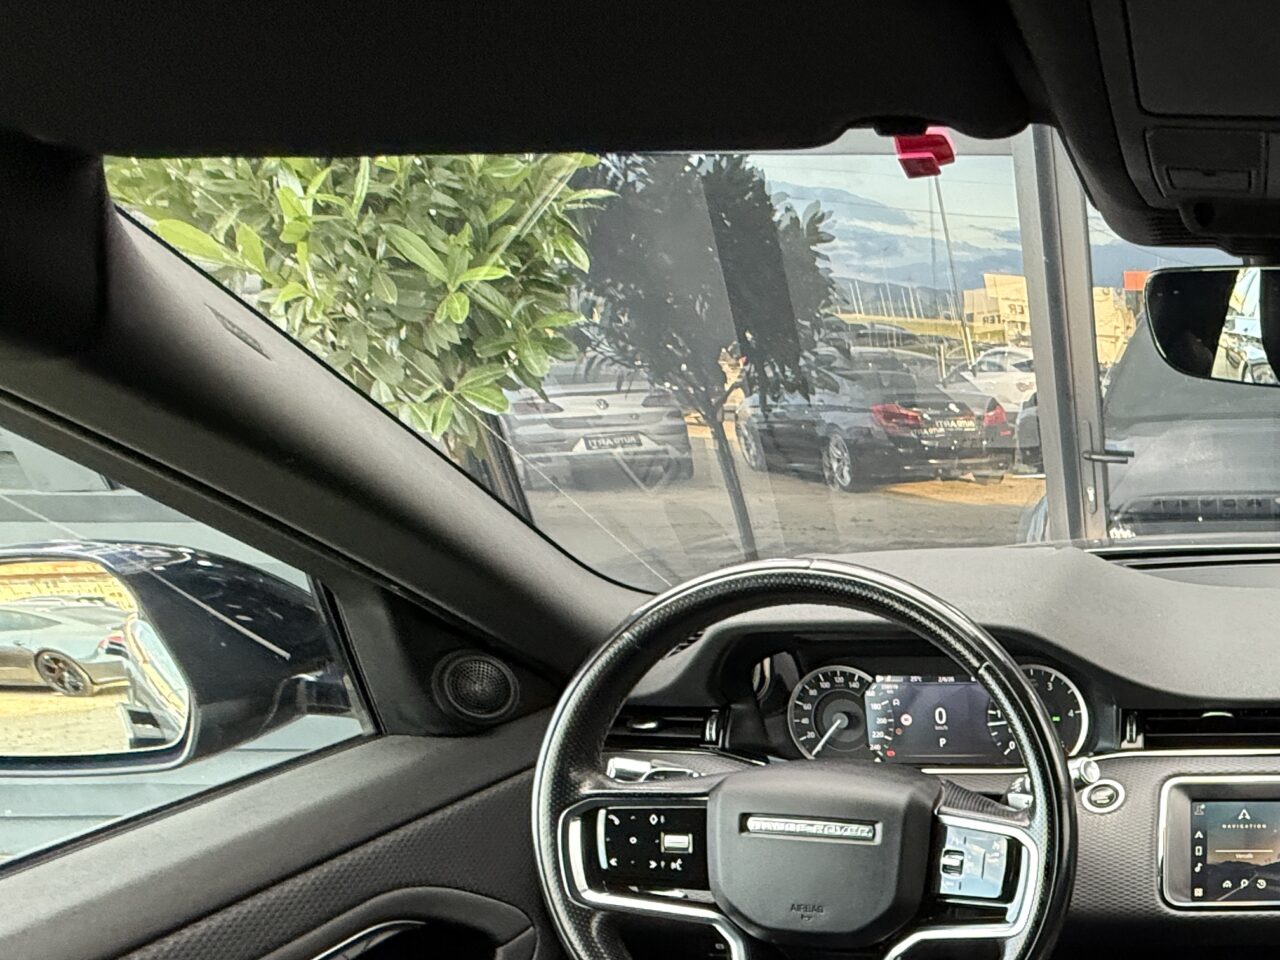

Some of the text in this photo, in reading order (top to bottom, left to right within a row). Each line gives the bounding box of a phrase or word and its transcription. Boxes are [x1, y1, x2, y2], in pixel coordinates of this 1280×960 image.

[820, 681, 831, 689] 100
[848, 681, 860, 689] 140
[1047, 682, 1054, 692] 3
[934, 707, 947, 725] 0
[1067, 708, 1075, 717] 4
[806, 730, 816, 739] 20
[871, 730, 885, 739] 220
[939, 738, 947, 748] P
[1008, 740, 1016, 750] 0
[812, 823, 874, 838] ROVER
[790, 903, 825, 914] AIRBAG
